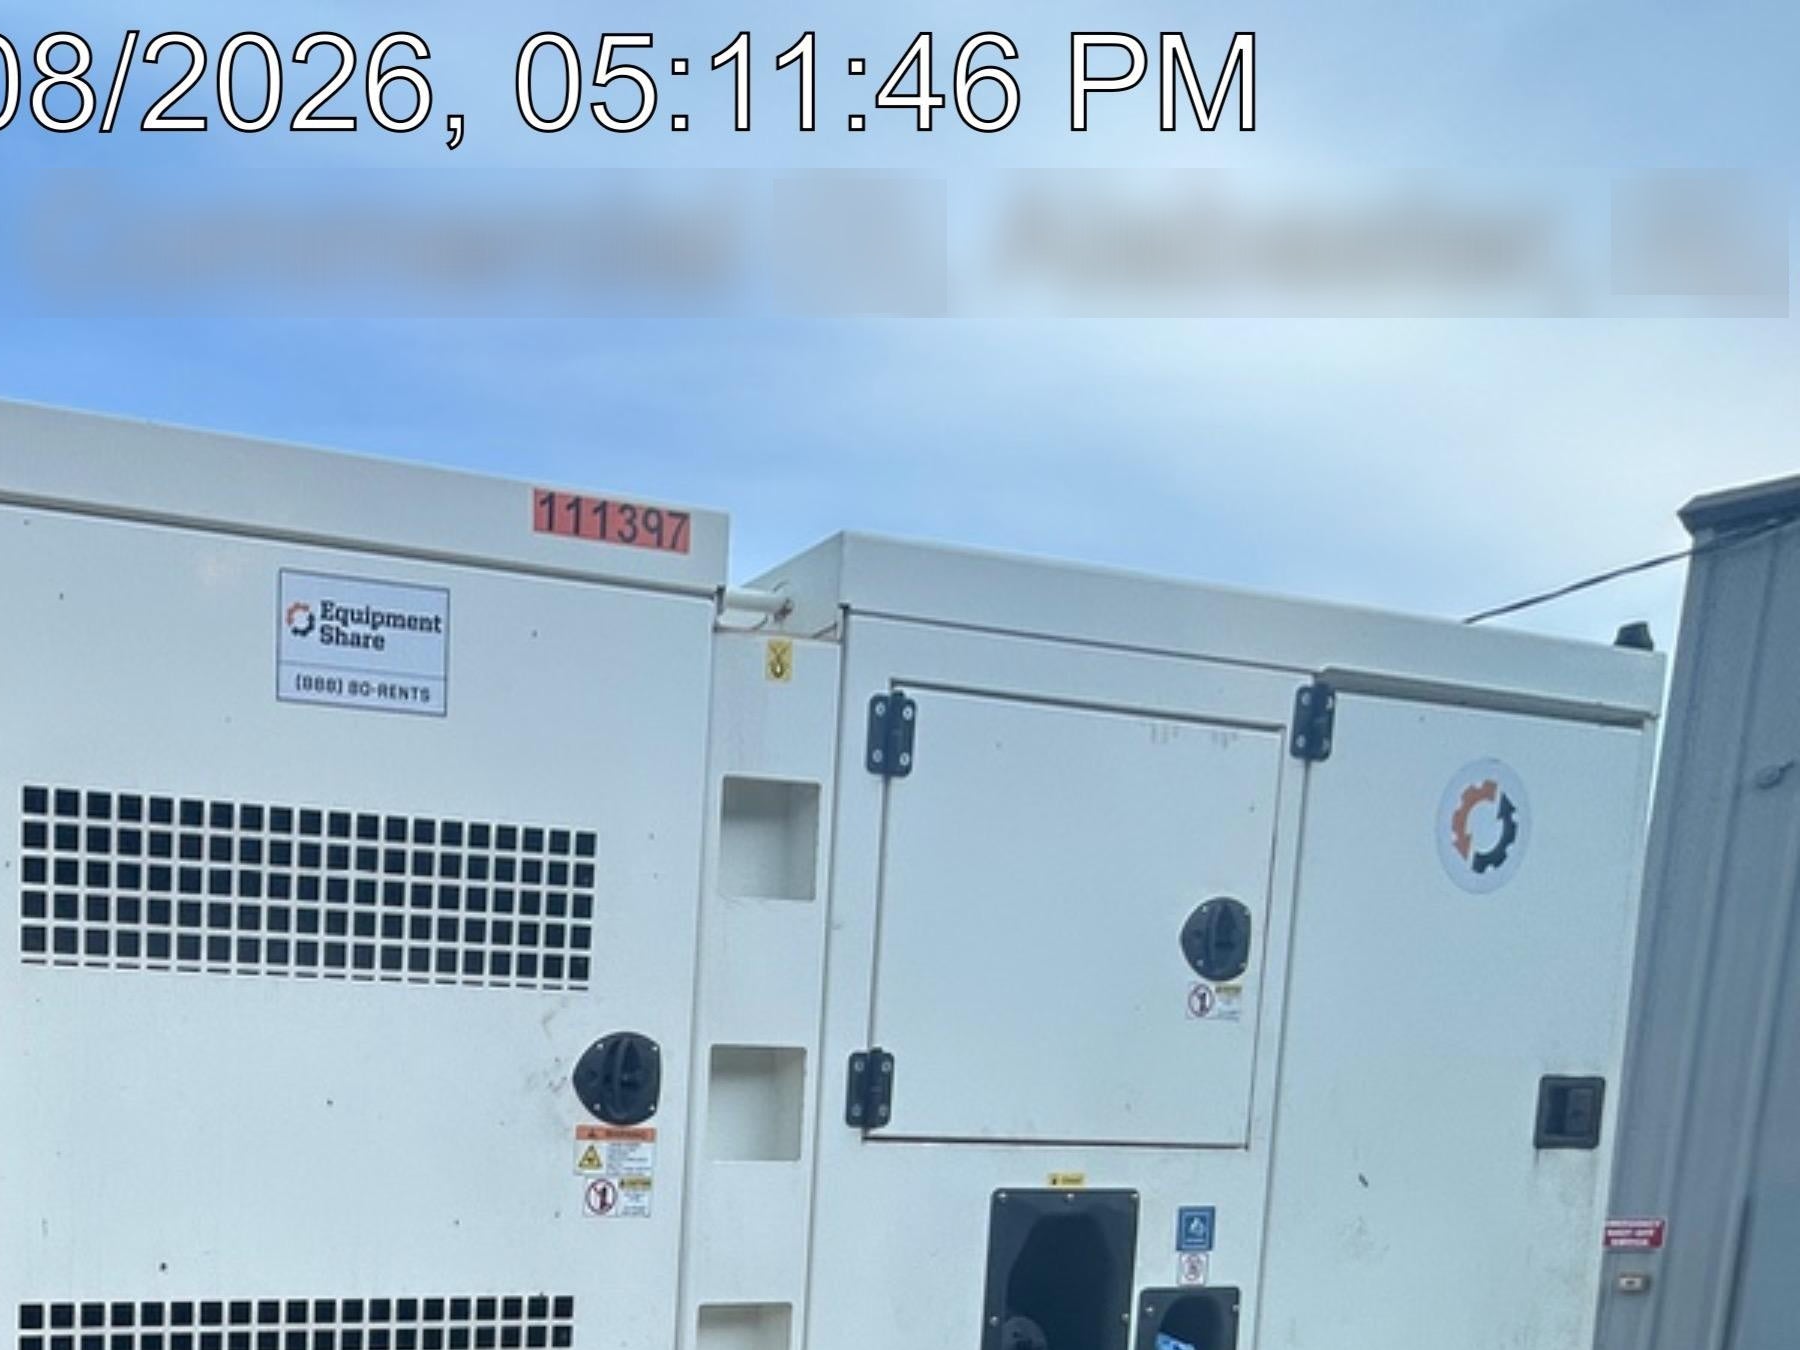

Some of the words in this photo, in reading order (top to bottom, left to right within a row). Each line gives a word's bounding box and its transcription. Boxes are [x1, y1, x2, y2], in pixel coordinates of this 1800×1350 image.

[538, 491, 691, 550] 111397
[319, 599, 443, 635] Equipment
[319, 623, 386, 652] Share
